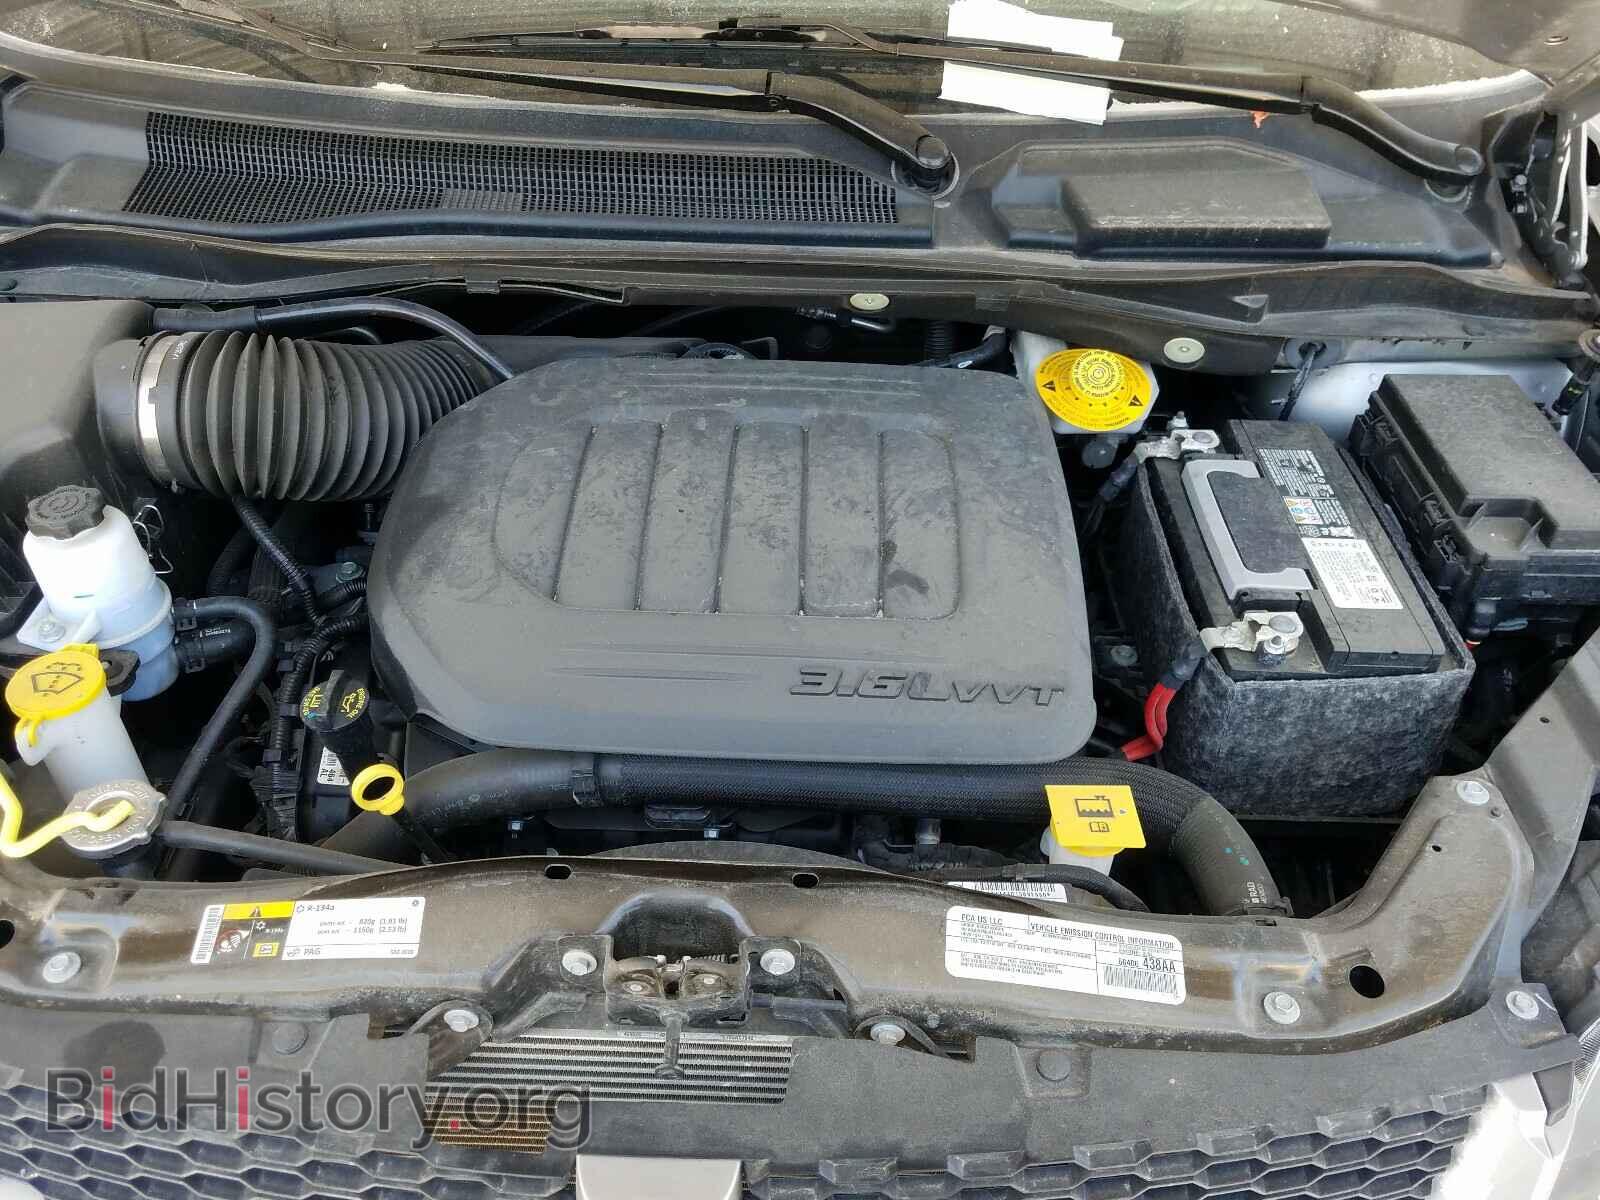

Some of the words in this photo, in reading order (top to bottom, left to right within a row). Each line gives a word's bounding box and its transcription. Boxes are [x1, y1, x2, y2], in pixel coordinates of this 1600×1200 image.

[1030, 922, 1059, 935] VEHICLE
[1060, 926, 1093, 940] EMISSION
[1094, 931, 1125, 944] CONTROL
[1127, 935, 1175, 950] INFORMATION
[1143, 957, 1176, 973] 438AA
